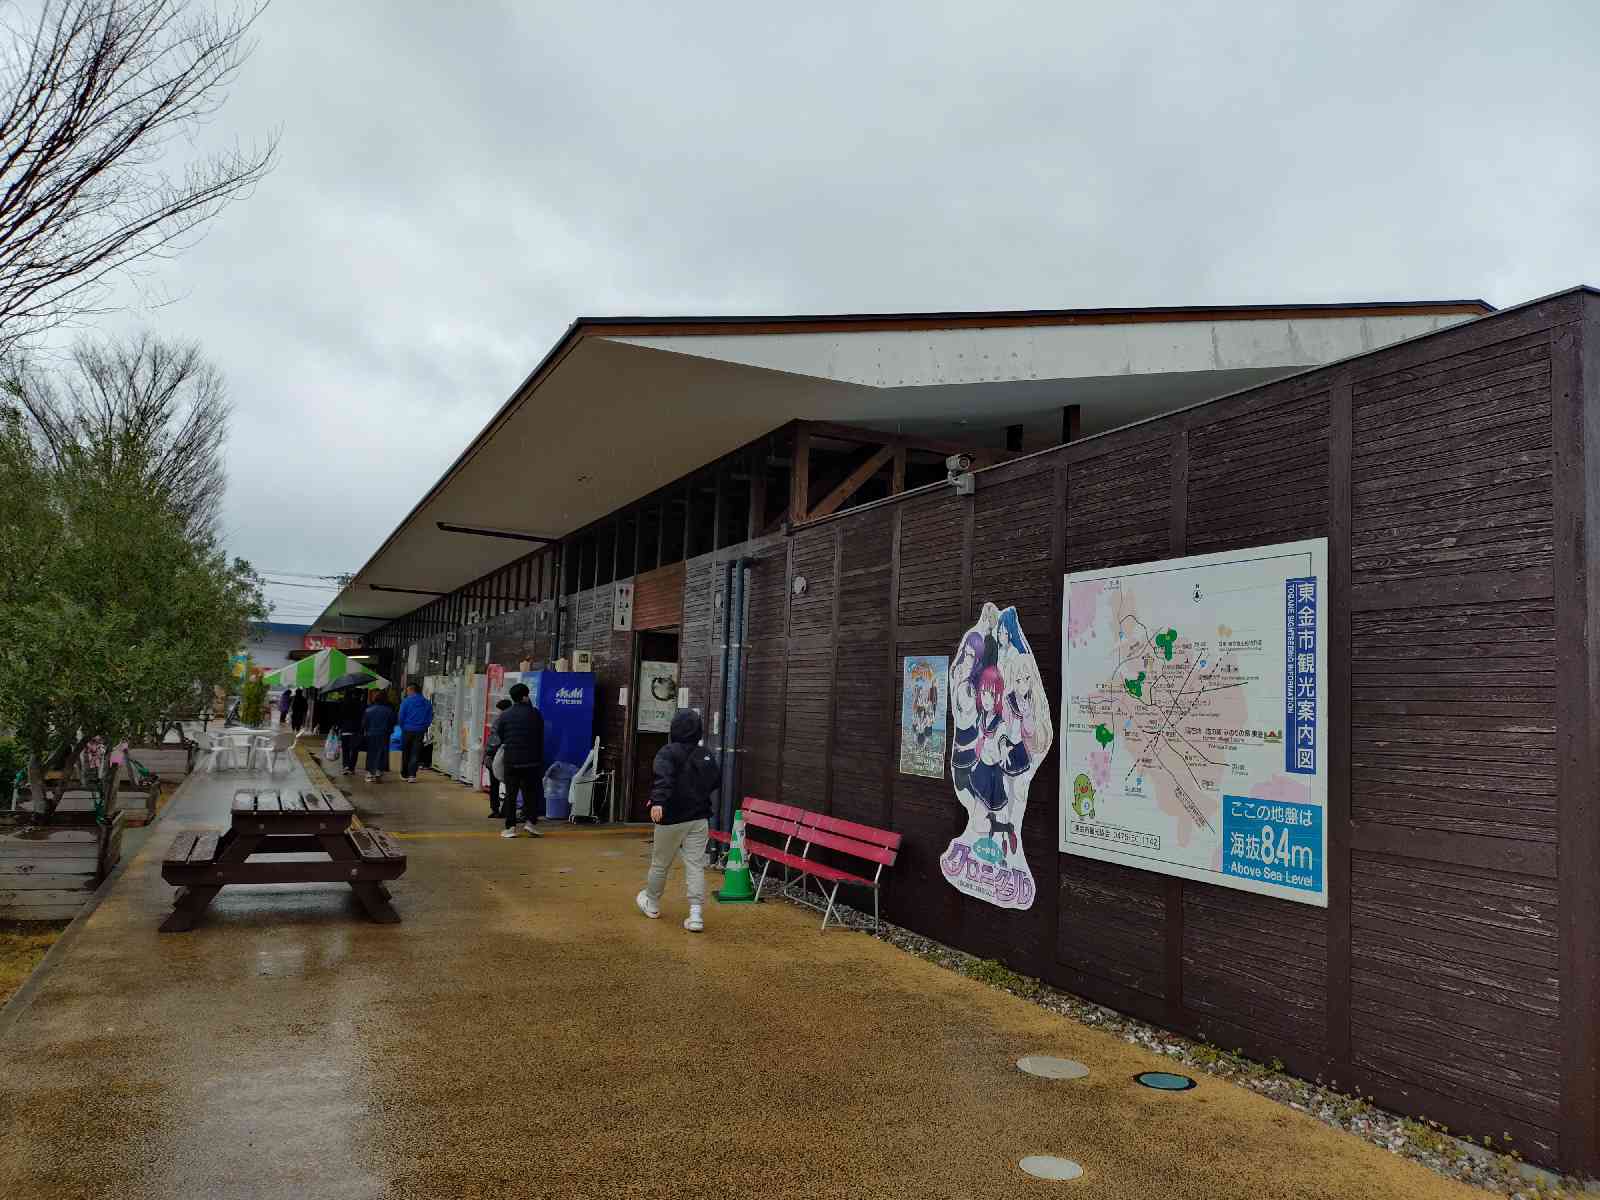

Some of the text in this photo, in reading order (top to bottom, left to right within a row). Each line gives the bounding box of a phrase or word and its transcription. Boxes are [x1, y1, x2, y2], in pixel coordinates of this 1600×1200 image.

[1287, 664, 1296, 714] INFORMATION
[1298, 583, 1315, 769] 東金市観光案内図
[1231, 801, 1313, 827] ここの地盤は
[1230, 861, 1313, 887] Above Sea Level
